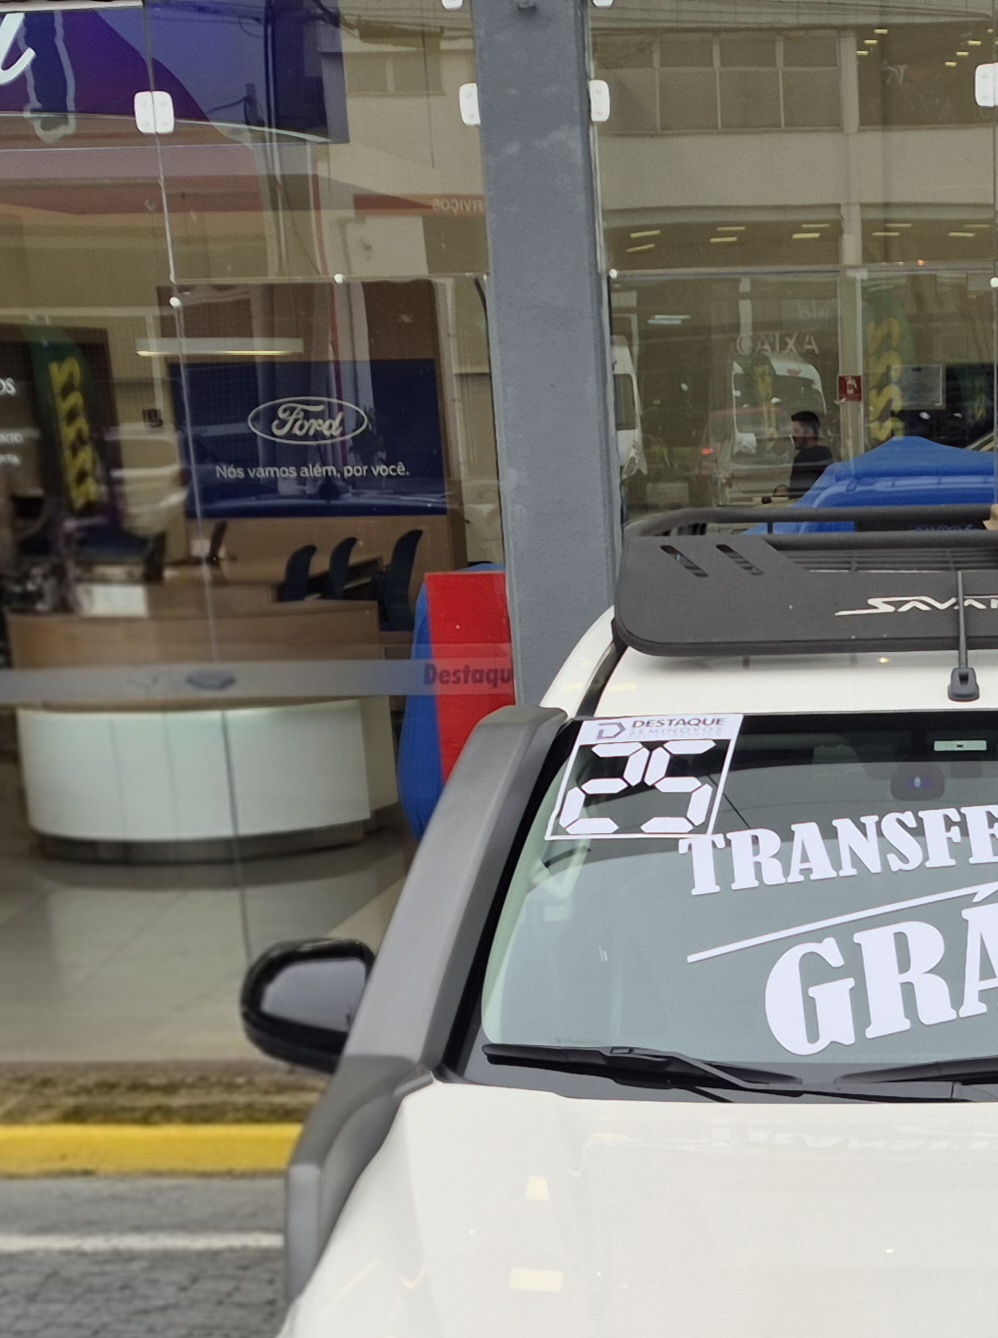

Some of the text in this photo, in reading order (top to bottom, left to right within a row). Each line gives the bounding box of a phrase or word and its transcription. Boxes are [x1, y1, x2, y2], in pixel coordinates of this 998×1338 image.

[271, 402, 344, 437] Ford
[215, 464, 245, 479] Nós
[248, 465, 298, 479] vamos
[344, 465, 368, 480] por
[371, 461, 411, 477] você.
[631, 717, 726, 729] DESTAQUE
[559, 739, 717, 835] 25
